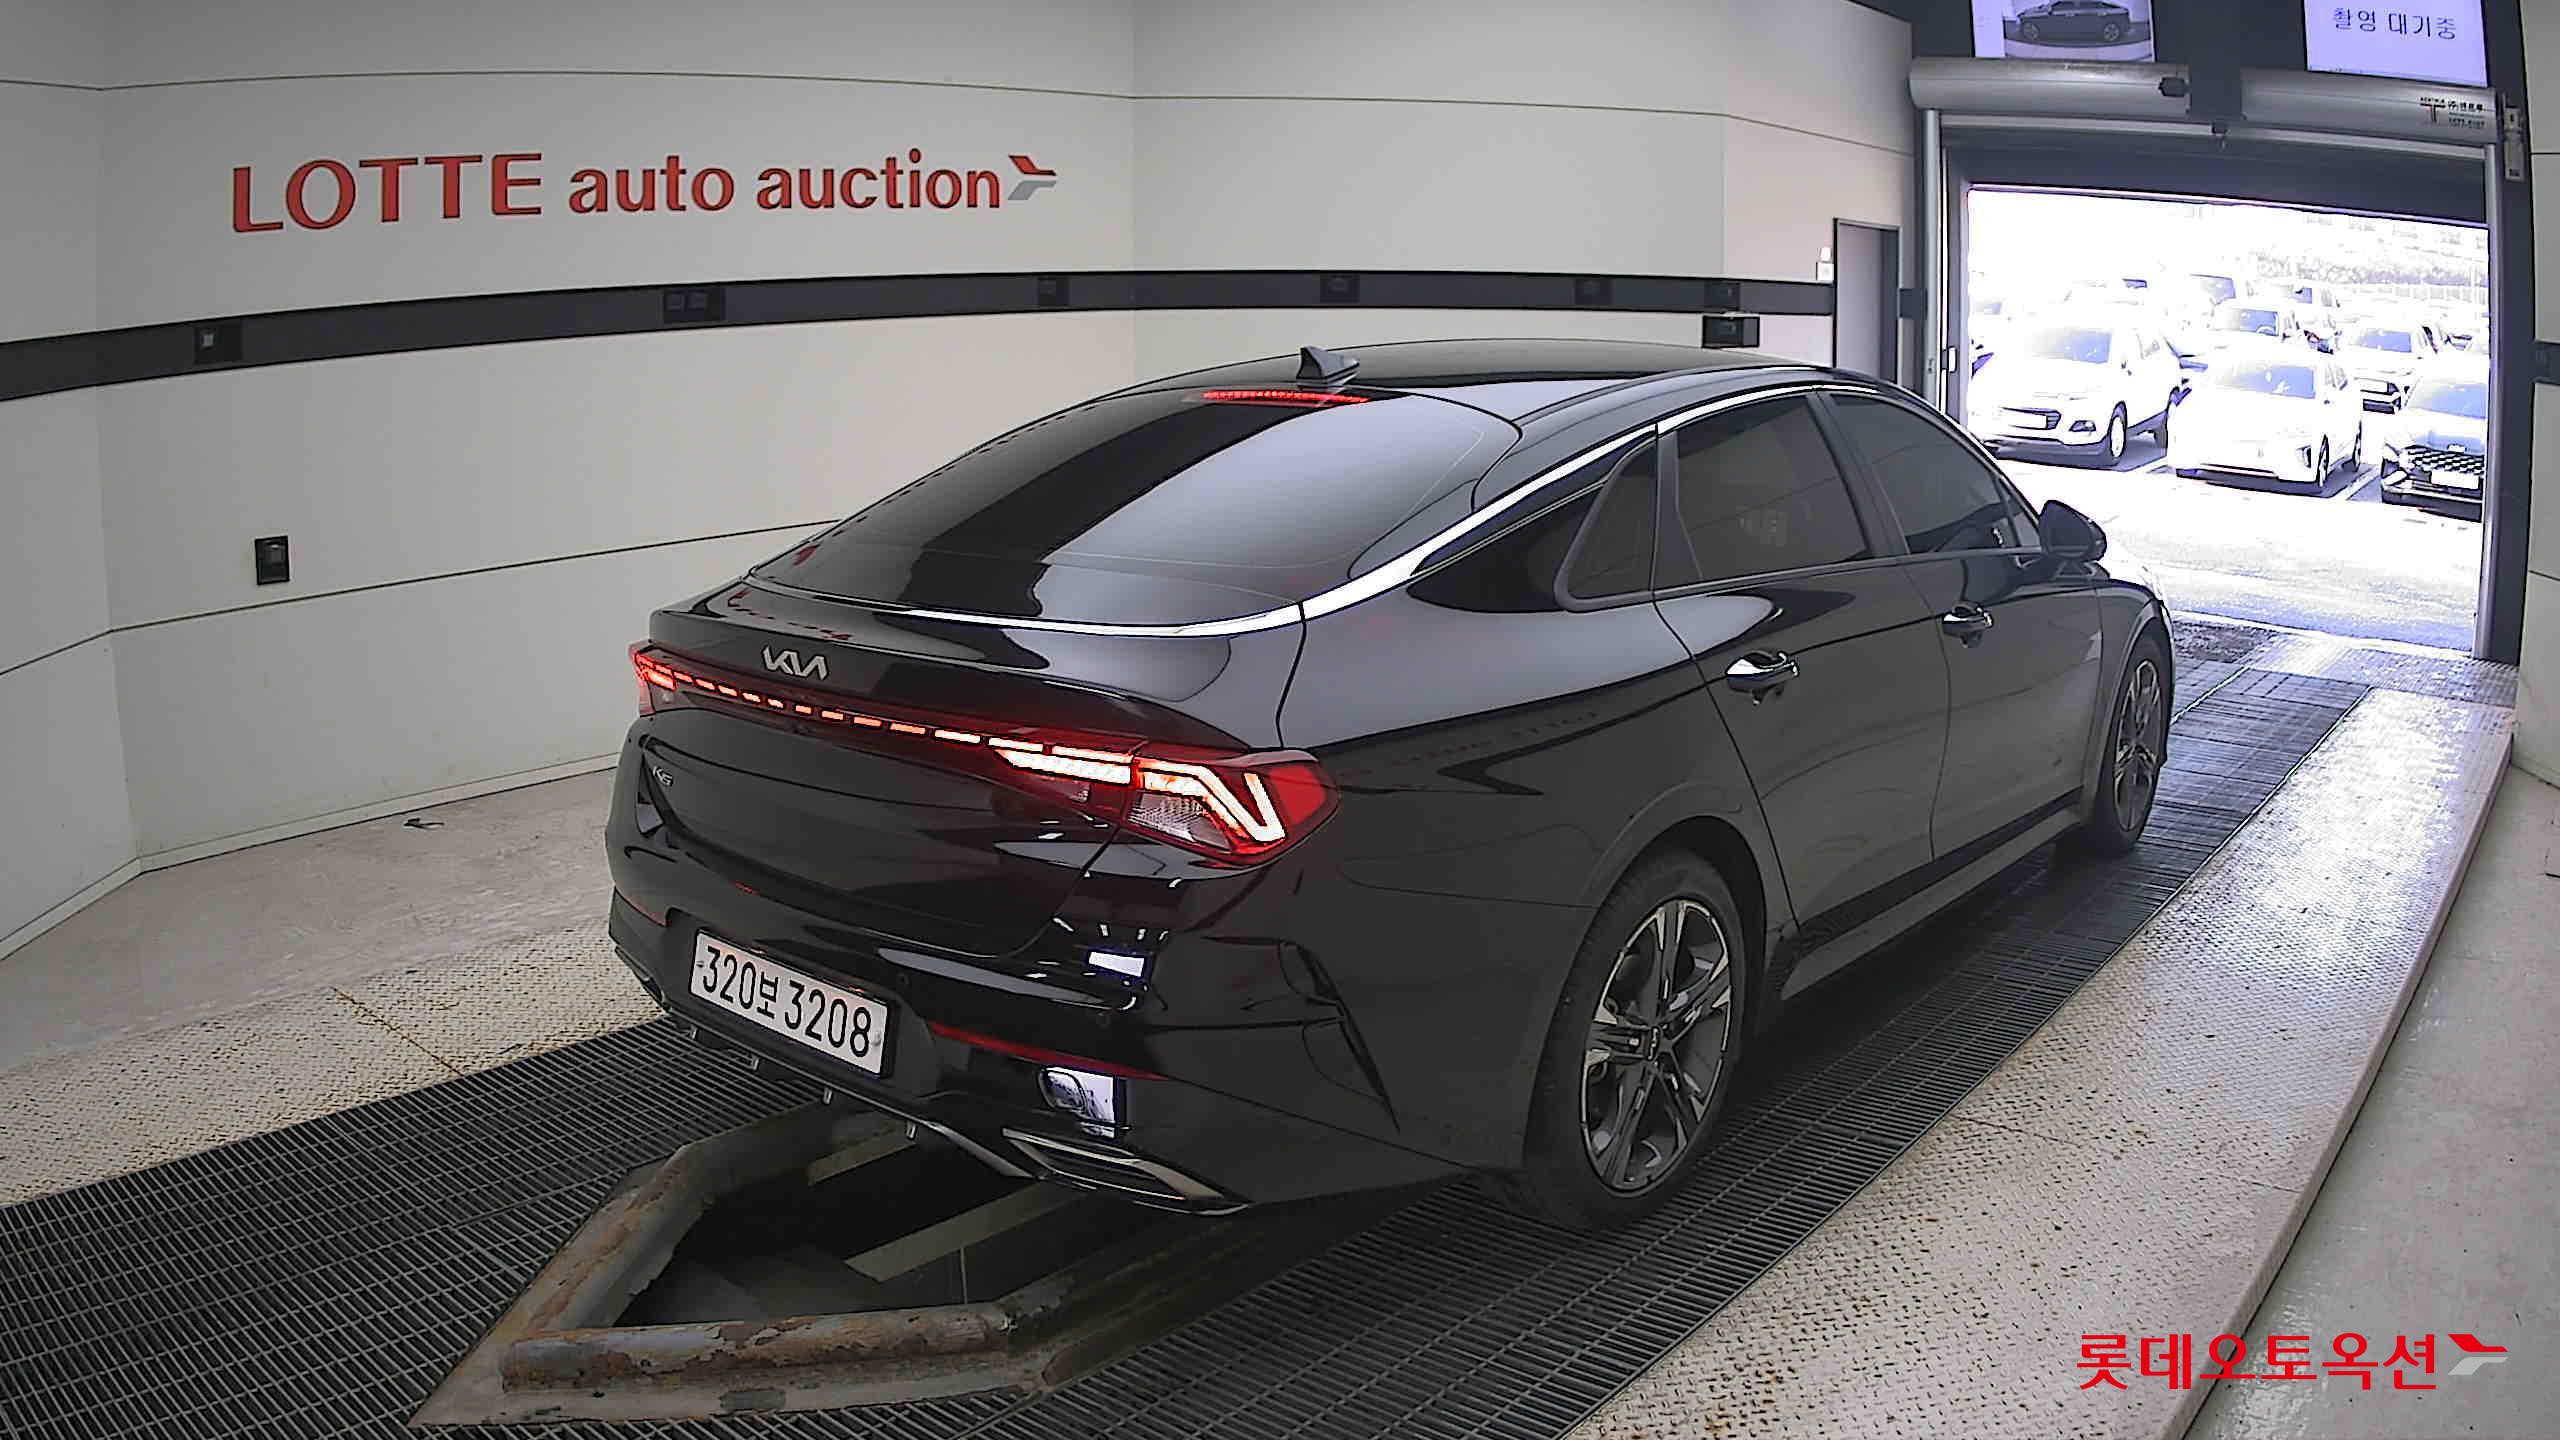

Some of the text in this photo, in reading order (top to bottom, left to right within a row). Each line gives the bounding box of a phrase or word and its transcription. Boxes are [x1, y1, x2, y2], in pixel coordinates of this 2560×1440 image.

[2333, 7, 2457, 40] 촬영 대기중
[233, 147, 1002, 233] LOTTE auto auction
